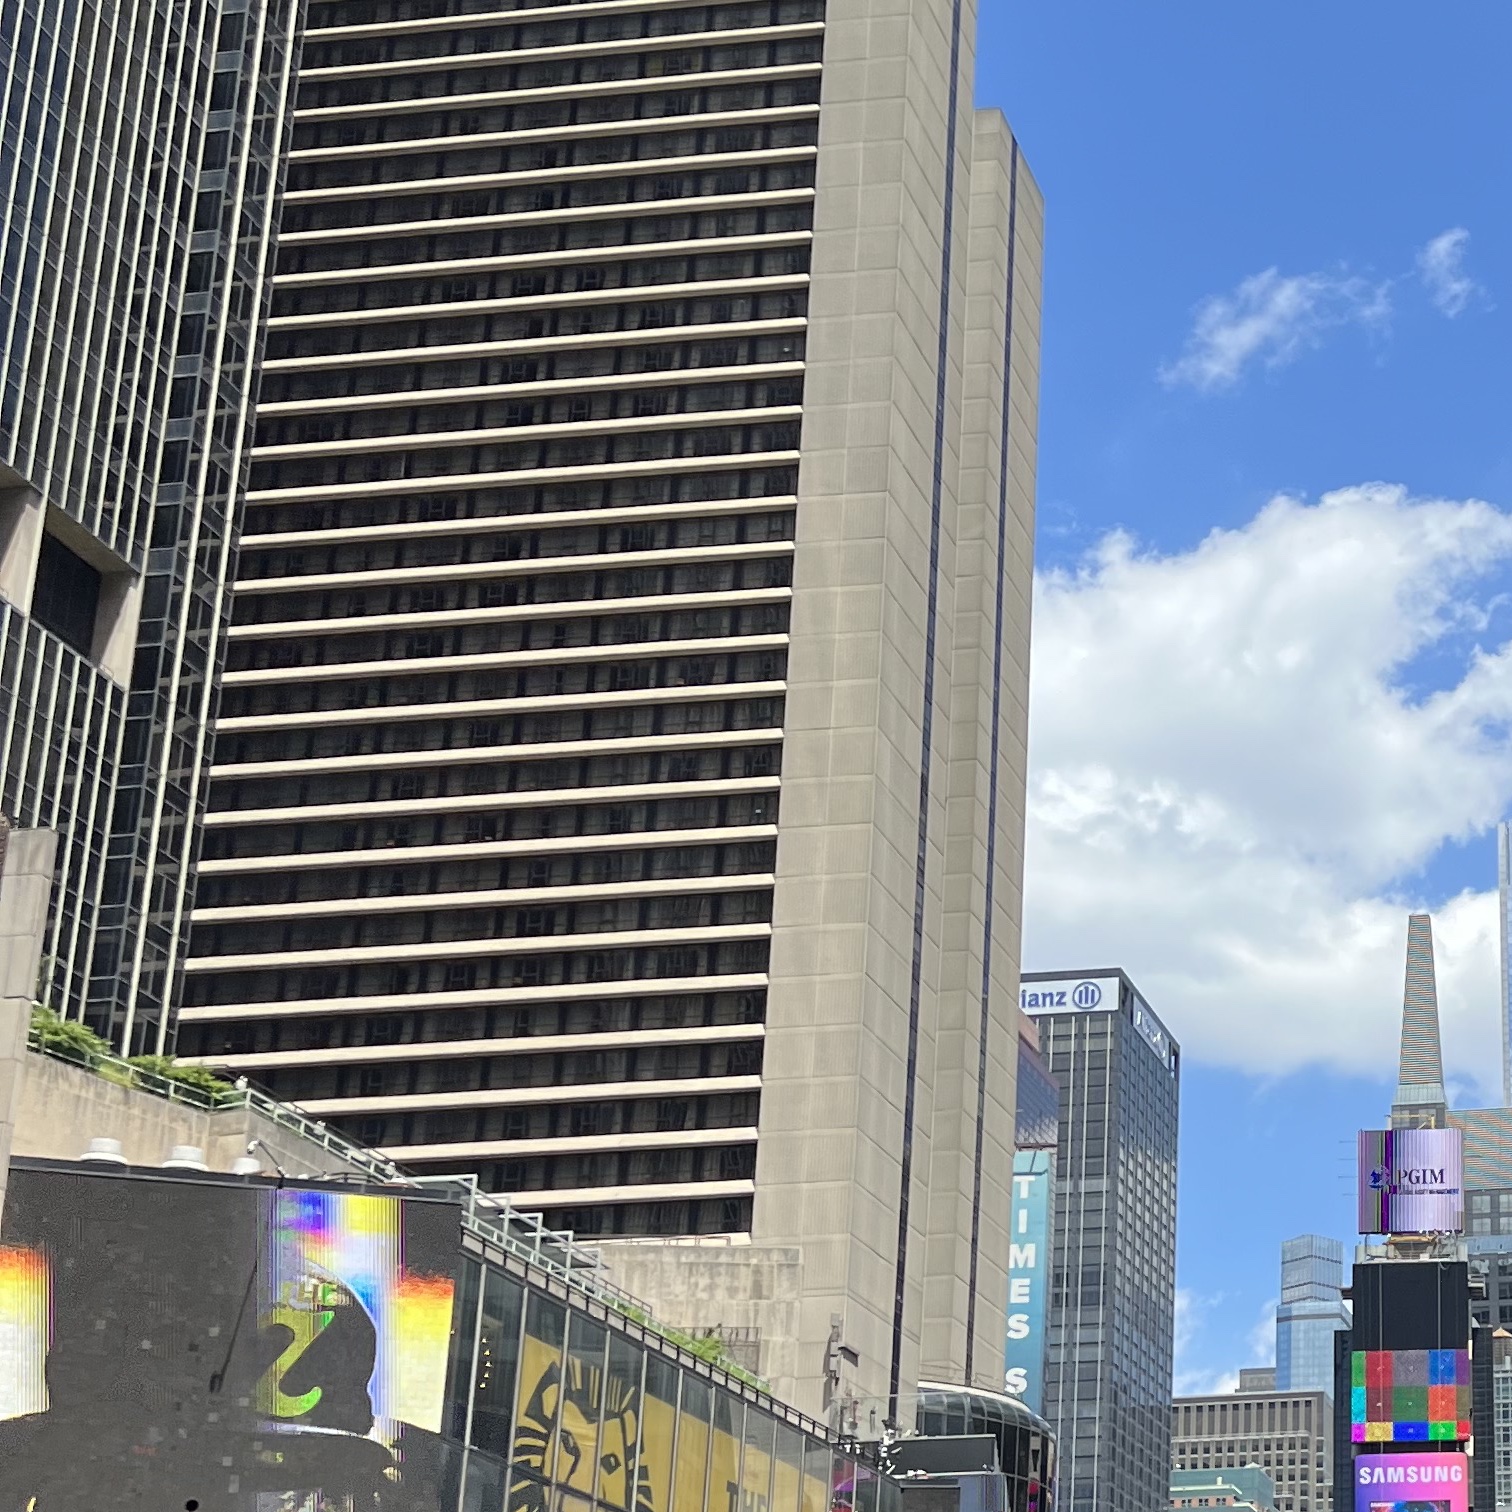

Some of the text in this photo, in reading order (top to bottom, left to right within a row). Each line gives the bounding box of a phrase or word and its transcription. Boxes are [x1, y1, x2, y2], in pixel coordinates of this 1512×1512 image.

[1021, 988, 1067, 1009] ianz
[1398, 1168, 1445, 1185] PGIM
[1359, 1465, 1463, 1484] SAMSUNG
